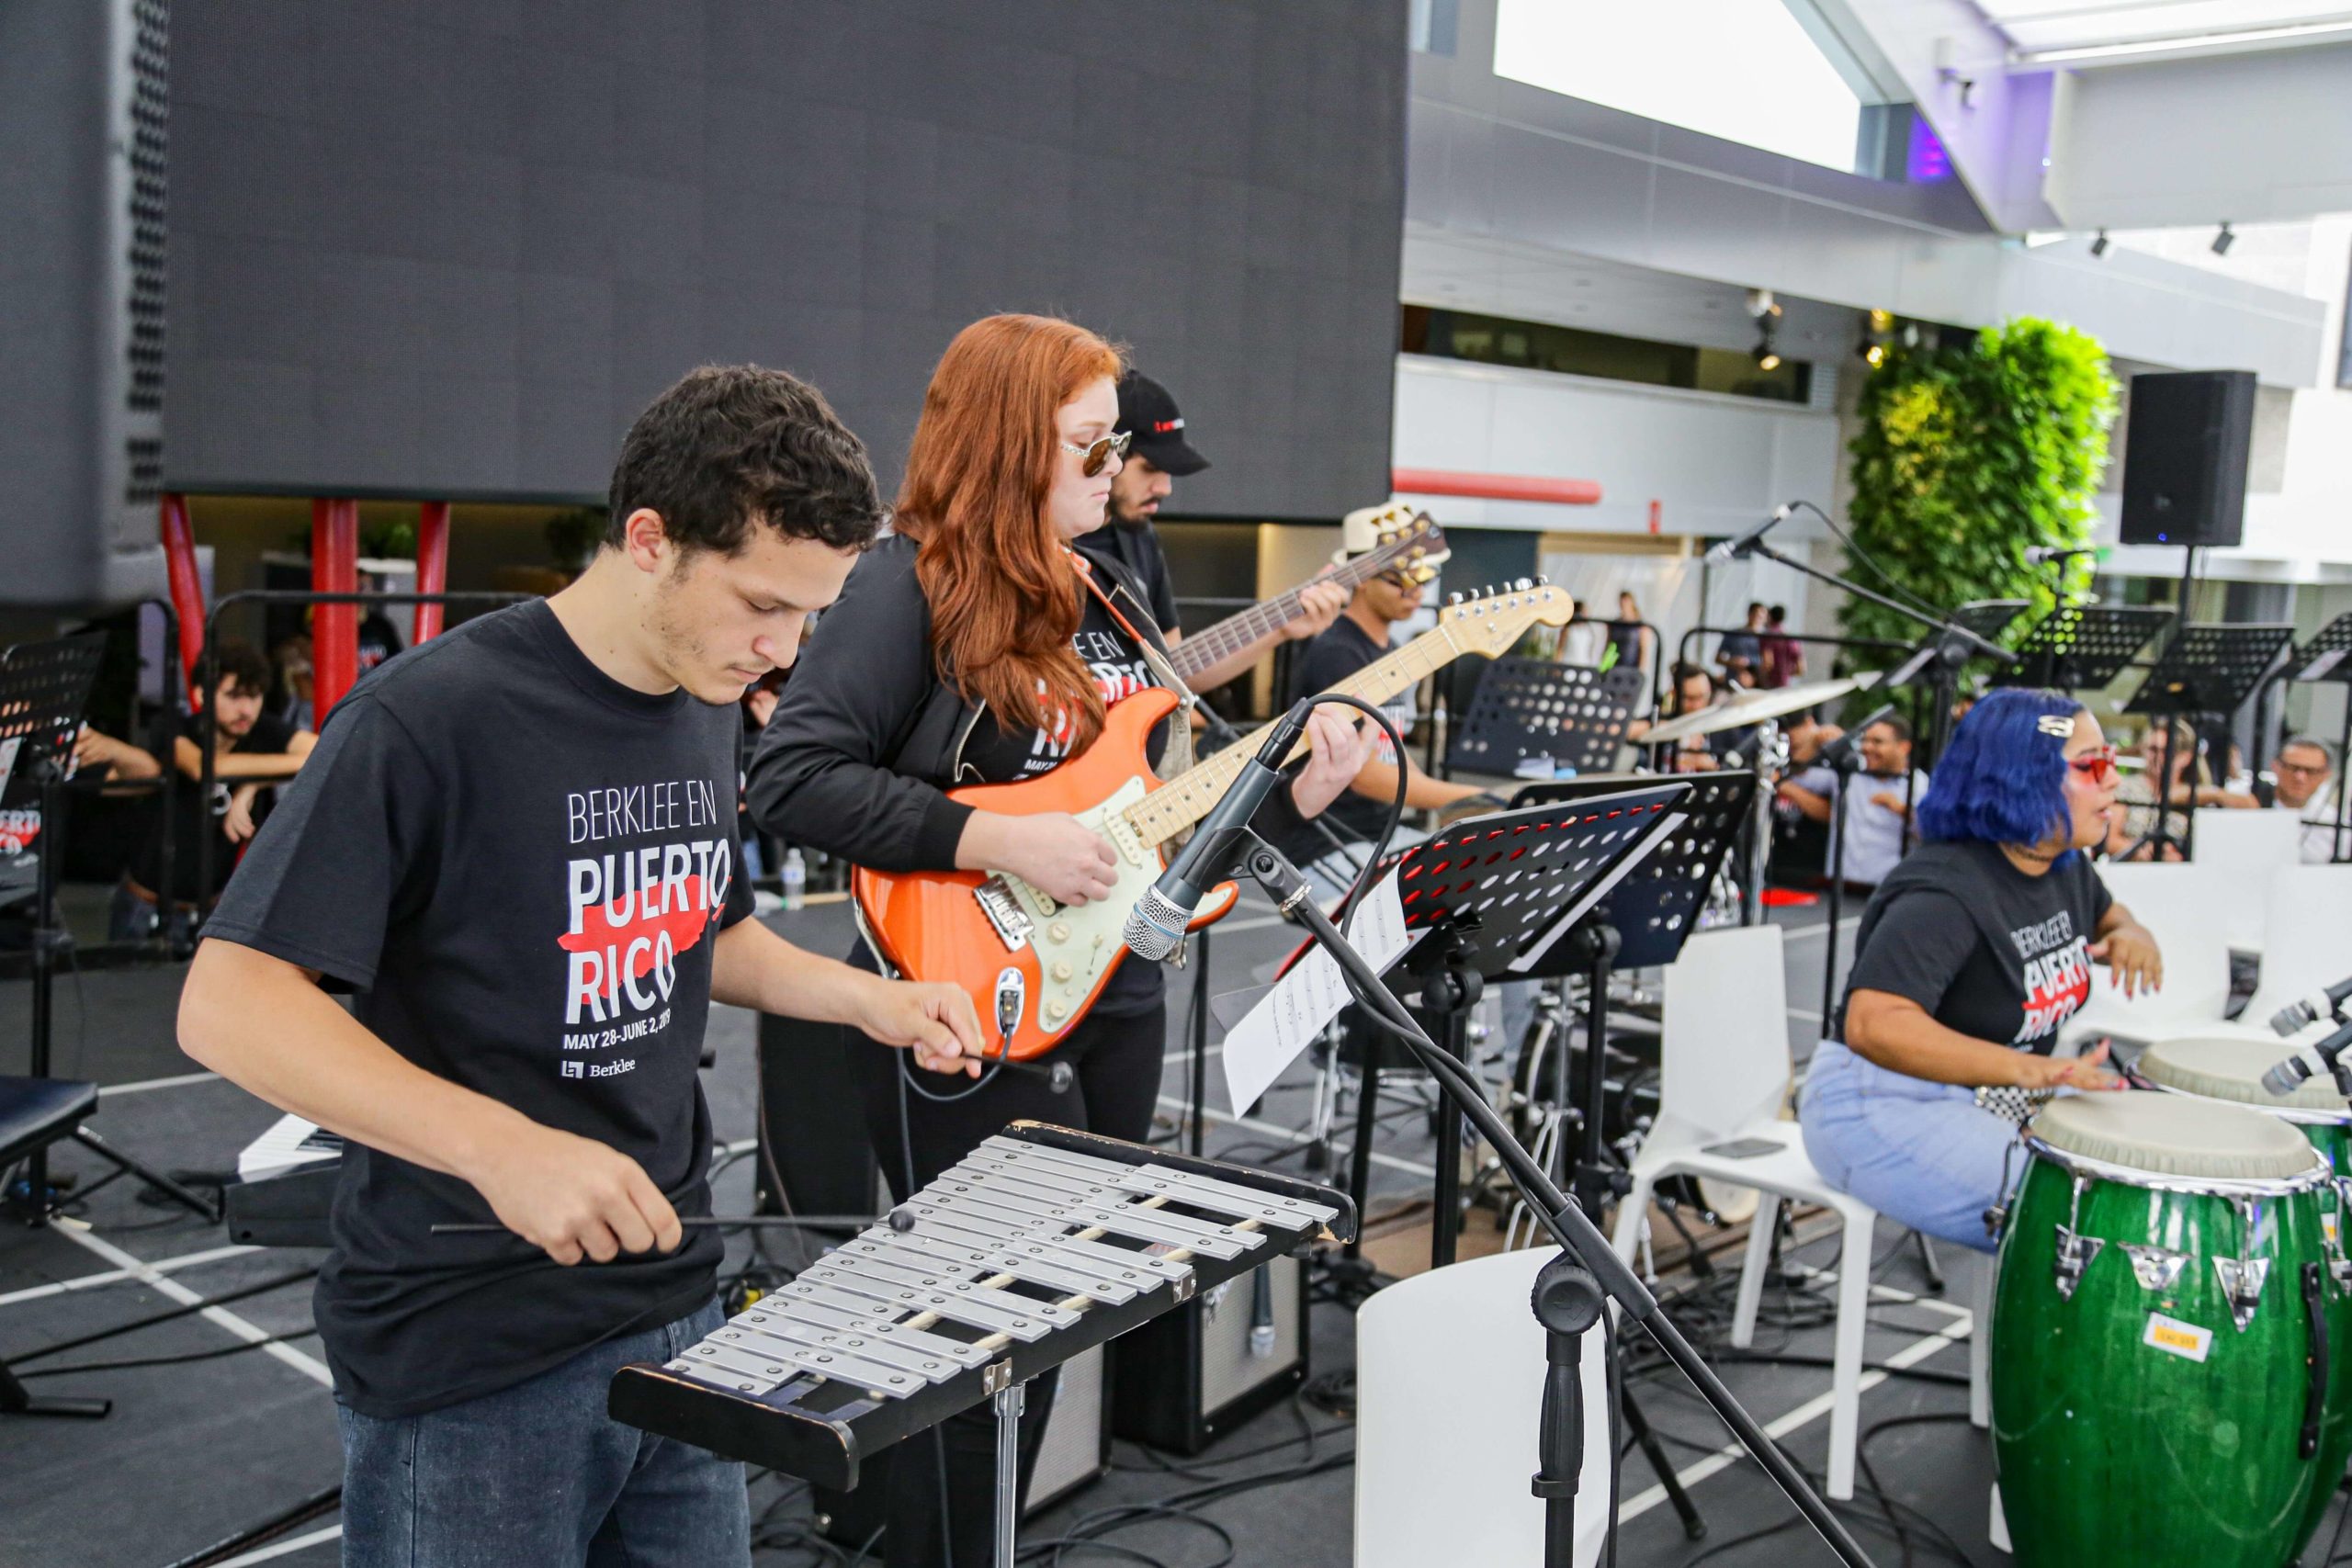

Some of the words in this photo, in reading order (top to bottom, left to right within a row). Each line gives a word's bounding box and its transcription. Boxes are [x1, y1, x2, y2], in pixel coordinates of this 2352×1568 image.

[1087, 631, 1125, 660] EN
[567, 781, 681, 844] BERKLEE
[686, 780, 718, 826] EN
[567, 838, 731, 935] PUERTO
[565, 930, 676, 1024] RICO
[562, 1033, 599, 1049] MAY
[601, 1020, 648, 1047] 28-JUNE
[588, 1058, 637, 1077] Berklee
